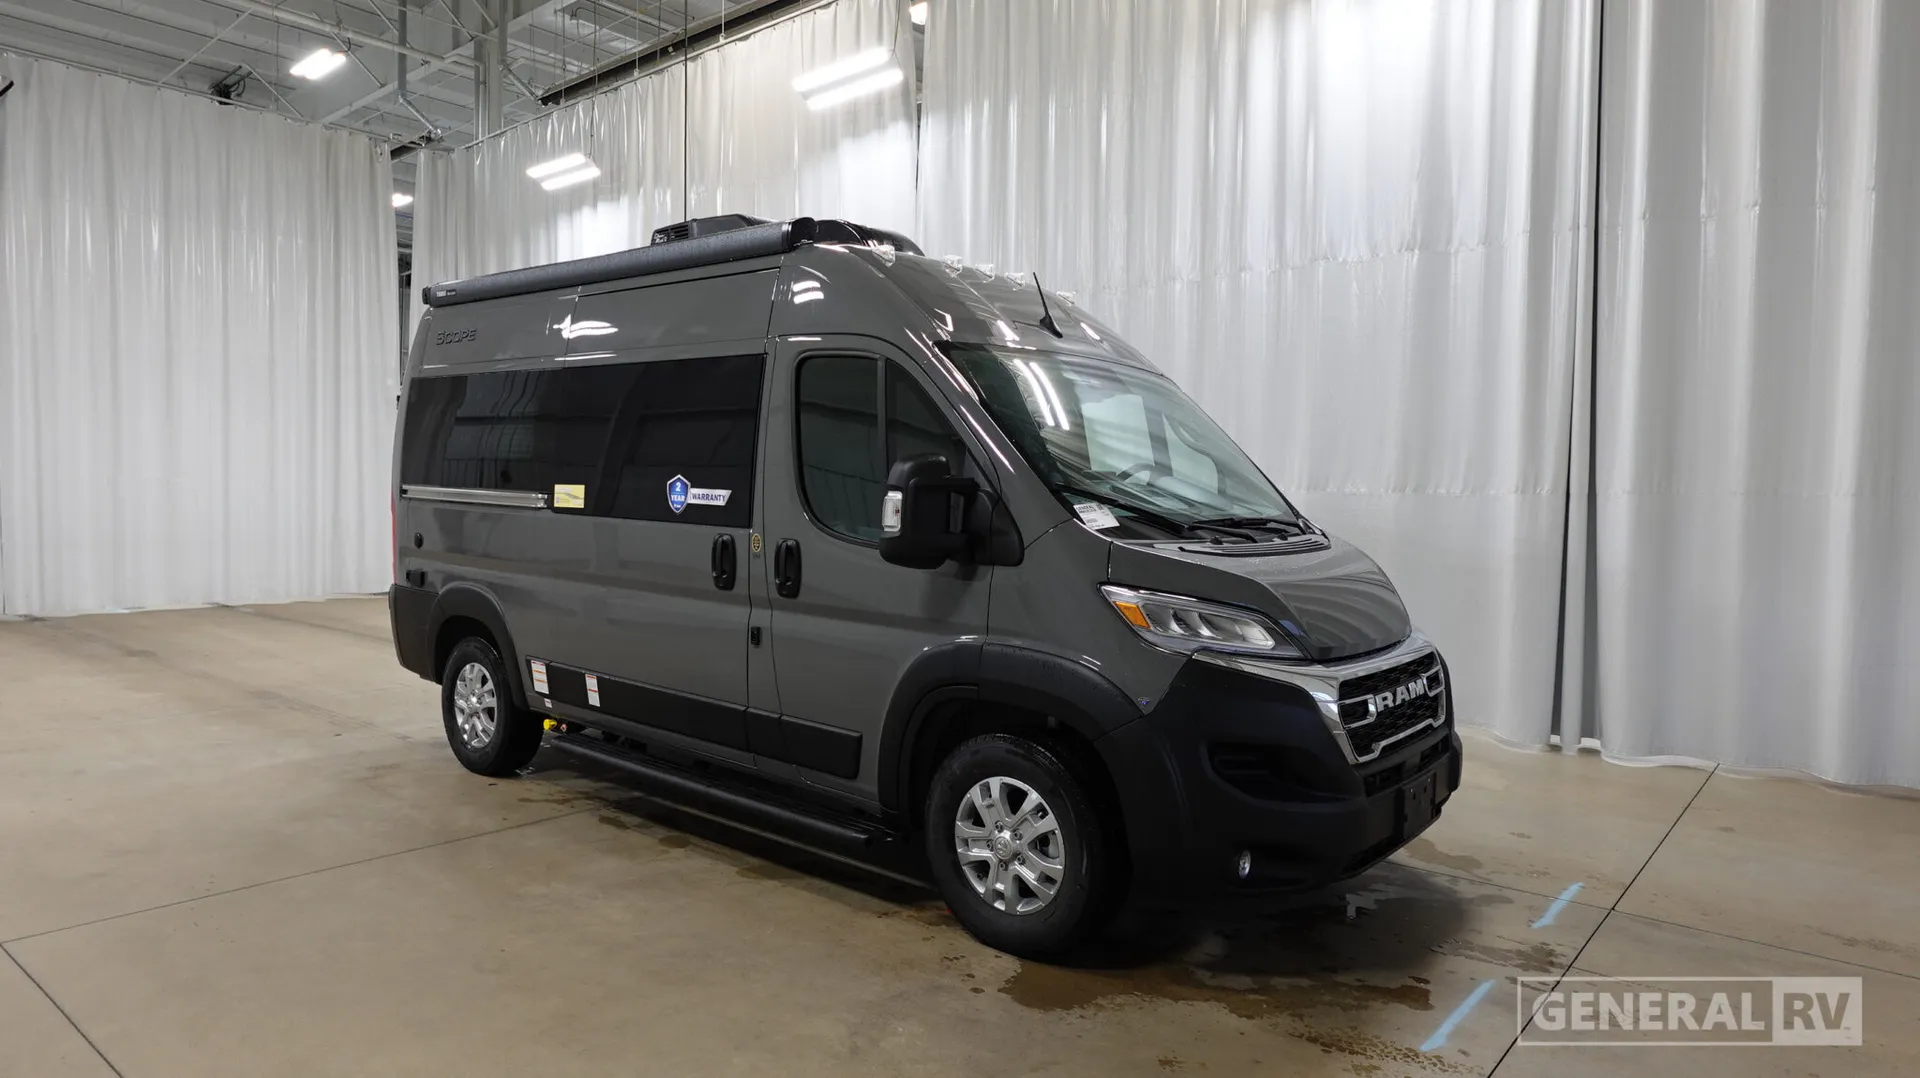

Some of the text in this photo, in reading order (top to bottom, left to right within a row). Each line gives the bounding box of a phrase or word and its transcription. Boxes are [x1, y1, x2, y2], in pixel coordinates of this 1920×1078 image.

[436, 329, 477, 346] SCOPE
[675, 481, 682, 492] 2
[671, 494, 685, 502] YEAR
[692, 493, 726, 502] WARRANTY
[1375, 679, 1425, 712] RAM
